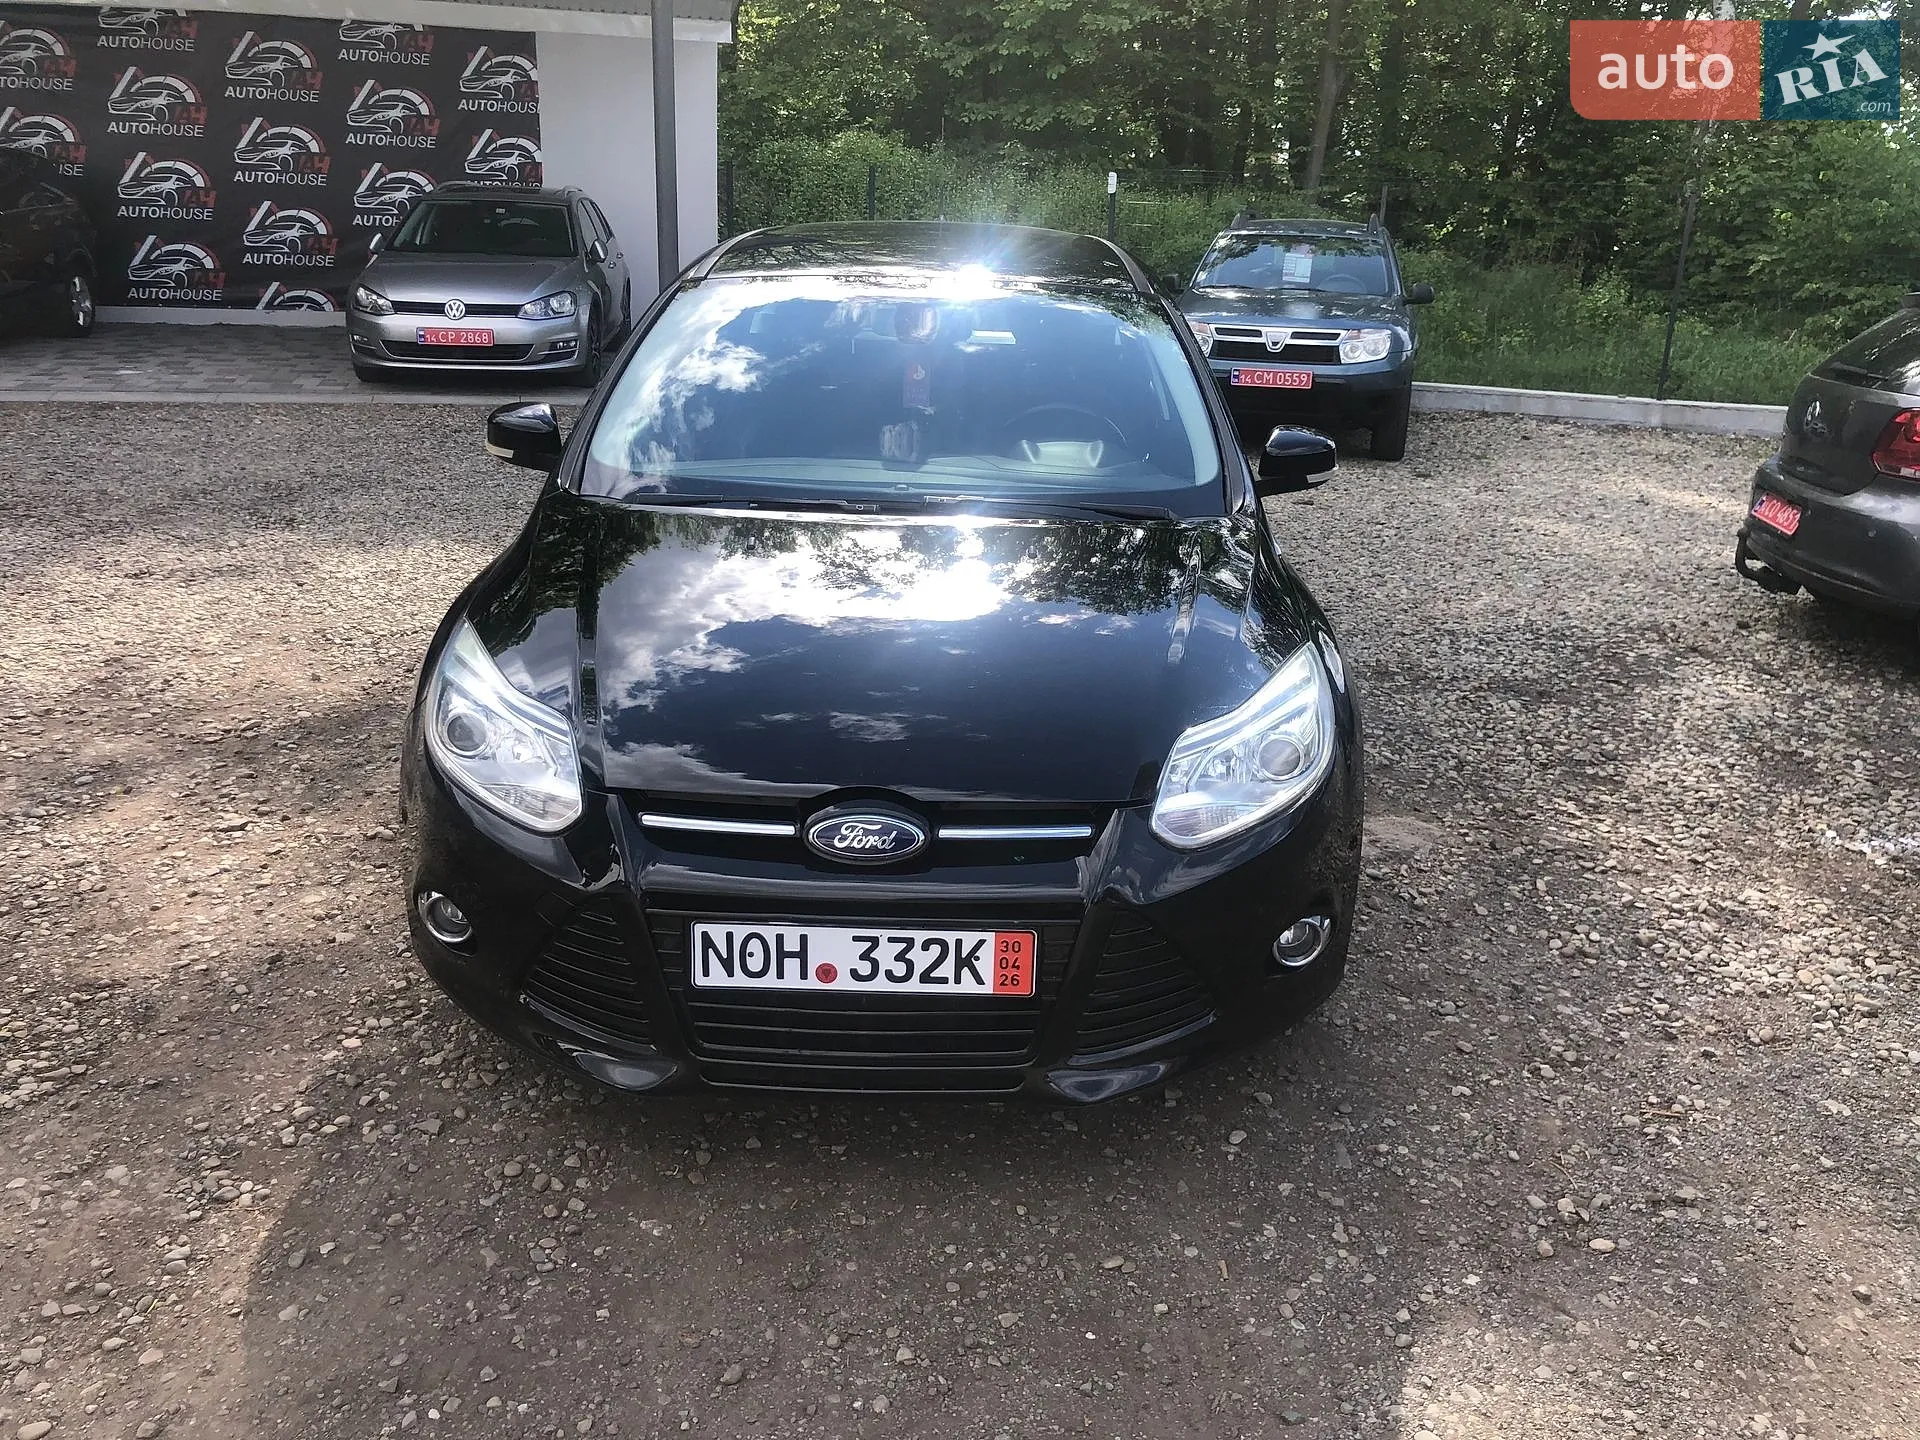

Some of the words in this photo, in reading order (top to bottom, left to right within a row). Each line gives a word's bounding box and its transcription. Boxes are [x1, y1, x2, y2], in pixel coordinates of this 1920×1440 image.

[97, 35, 195, 51] AUTOHOUSE
[338, 48, 431, 65] AUTOHOUSE
[225, 86, 320, 102] AUTOHOUSE
[107, 121, 204, 137] AUTOHOUSE
[345, 133, 437, 148] AUTOHOUSE
[233, 170, 328, 186] AUTOHOUSE
[117, 205, 214, 220] AUTOHOUSE
[242, 253, 335, 267] AUTOHOUSE
[128, 287, 223, 301] AUTOHOUSE
[425, 334, 437, 343] 14
[439, 331, 456, 343] CP
[460, 332, 489, 344] 2868
[1240, 374, 1252, 384] 14
[1254, 371, 1273, 384] CM
[1276, 372, 1308, 386] 0559
[834, 822, 897, 850] Ford
[1000, 940, 1021, 953] 30
[700, 930, 809, 981] NOH
[849, 935, 987, 986] 332K
[1000, 956, 1020, 970] 04
[999, 973, 1020, 986] 26
